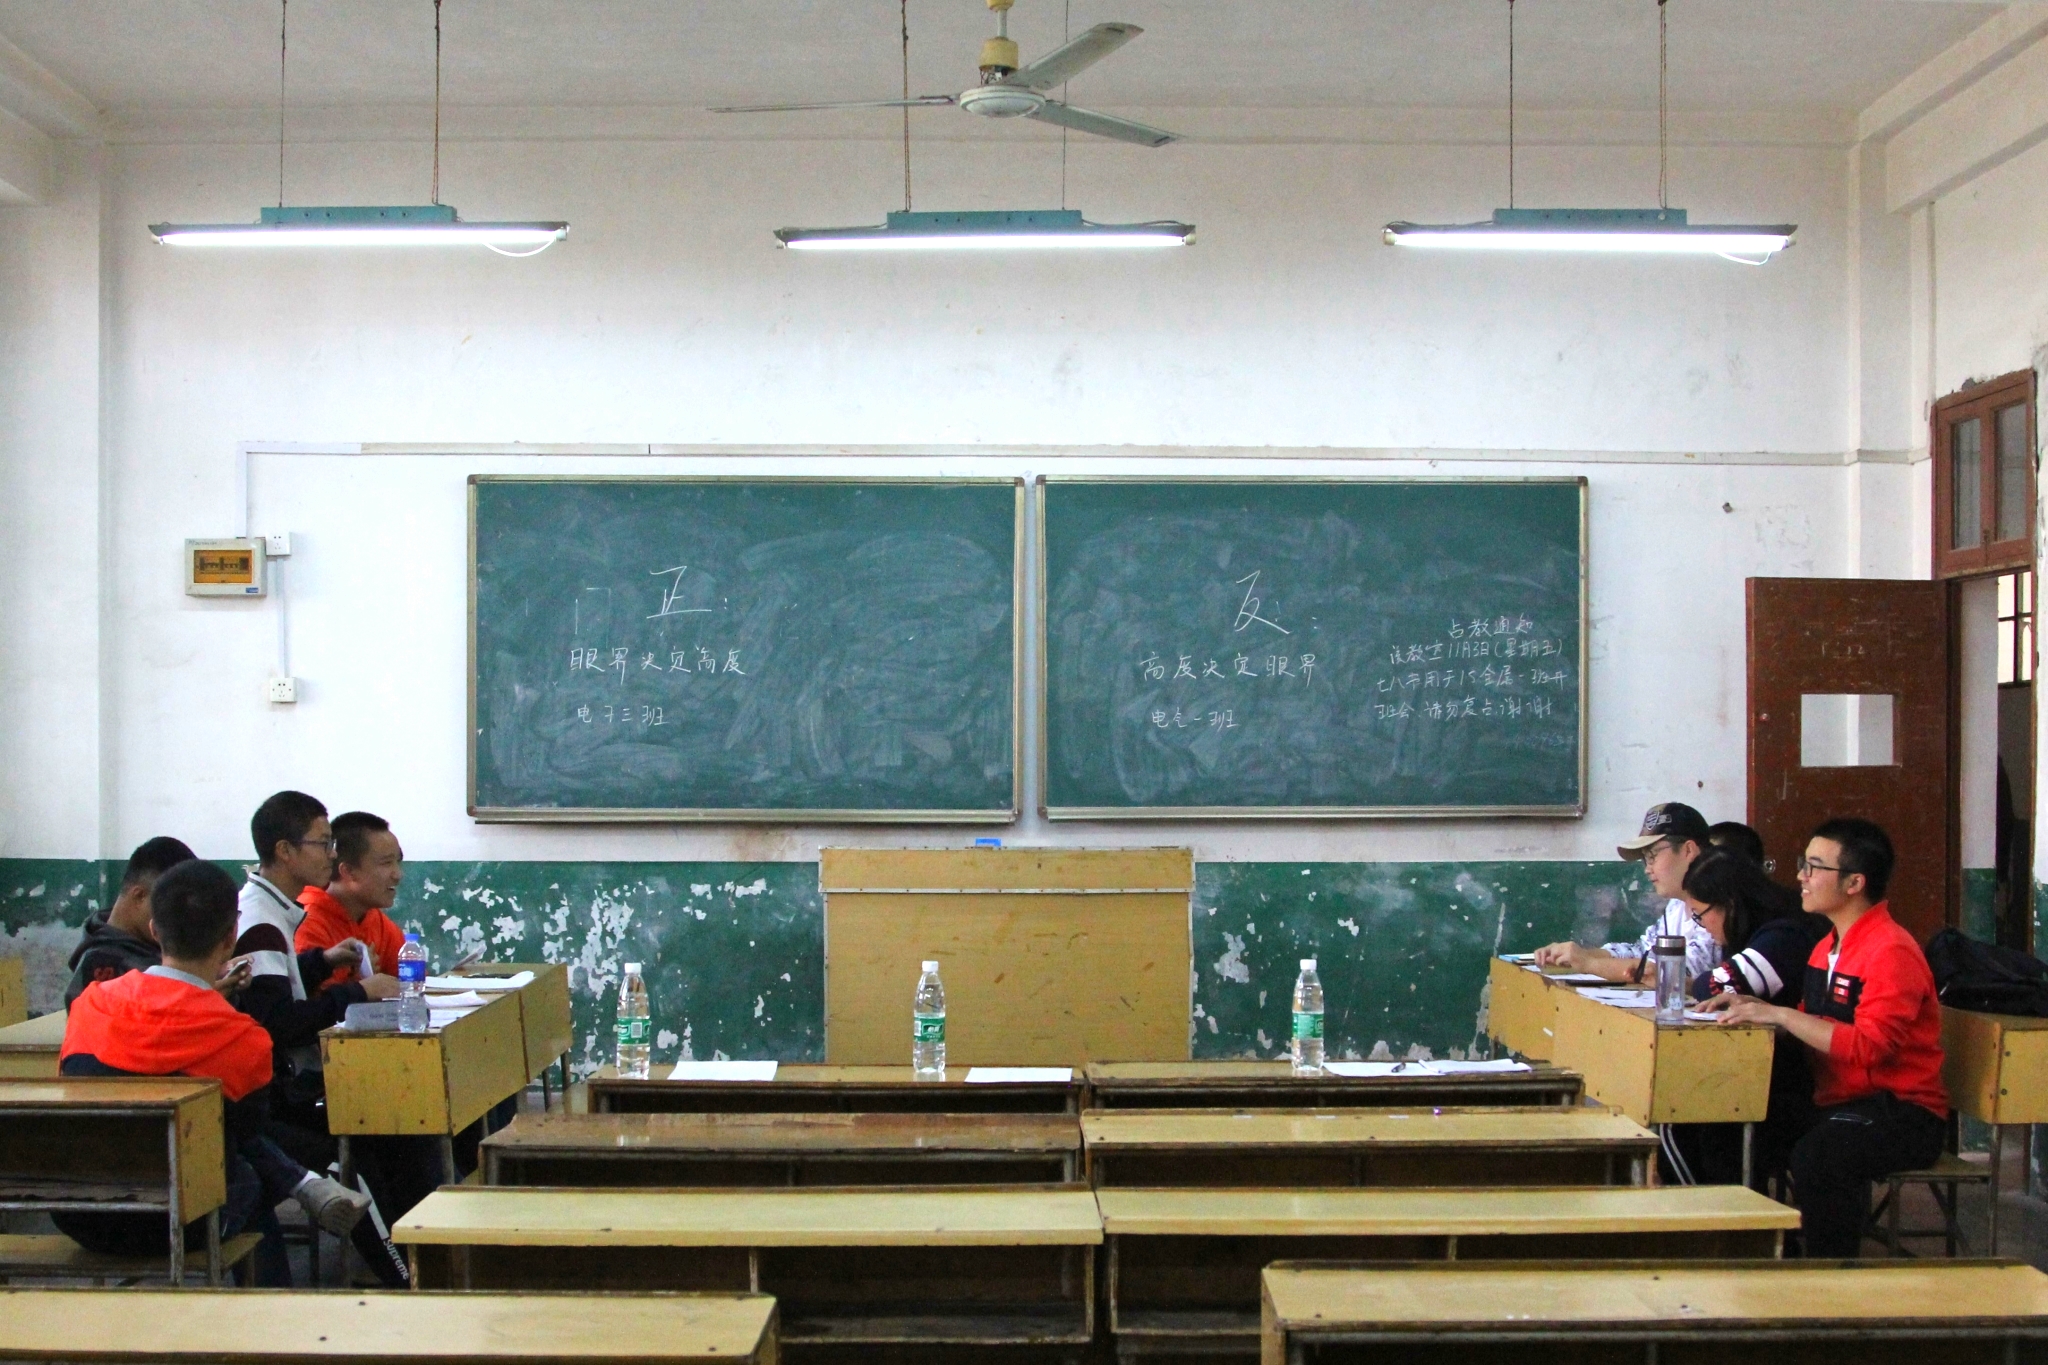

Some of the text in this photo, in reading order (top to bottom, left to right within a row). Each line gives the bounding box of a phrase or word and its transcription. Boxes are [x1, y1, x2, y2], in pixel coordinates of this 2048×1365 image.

[570, 645, 746, 686] 眼界决定高度
[1140, 651, 1316, 688] 高度决定眼界
[577, 704, 669, 726] 电子三班
[1152, 706, 1239, 732] 电气一班
[383, 1239, 409, 1280] Supreme
